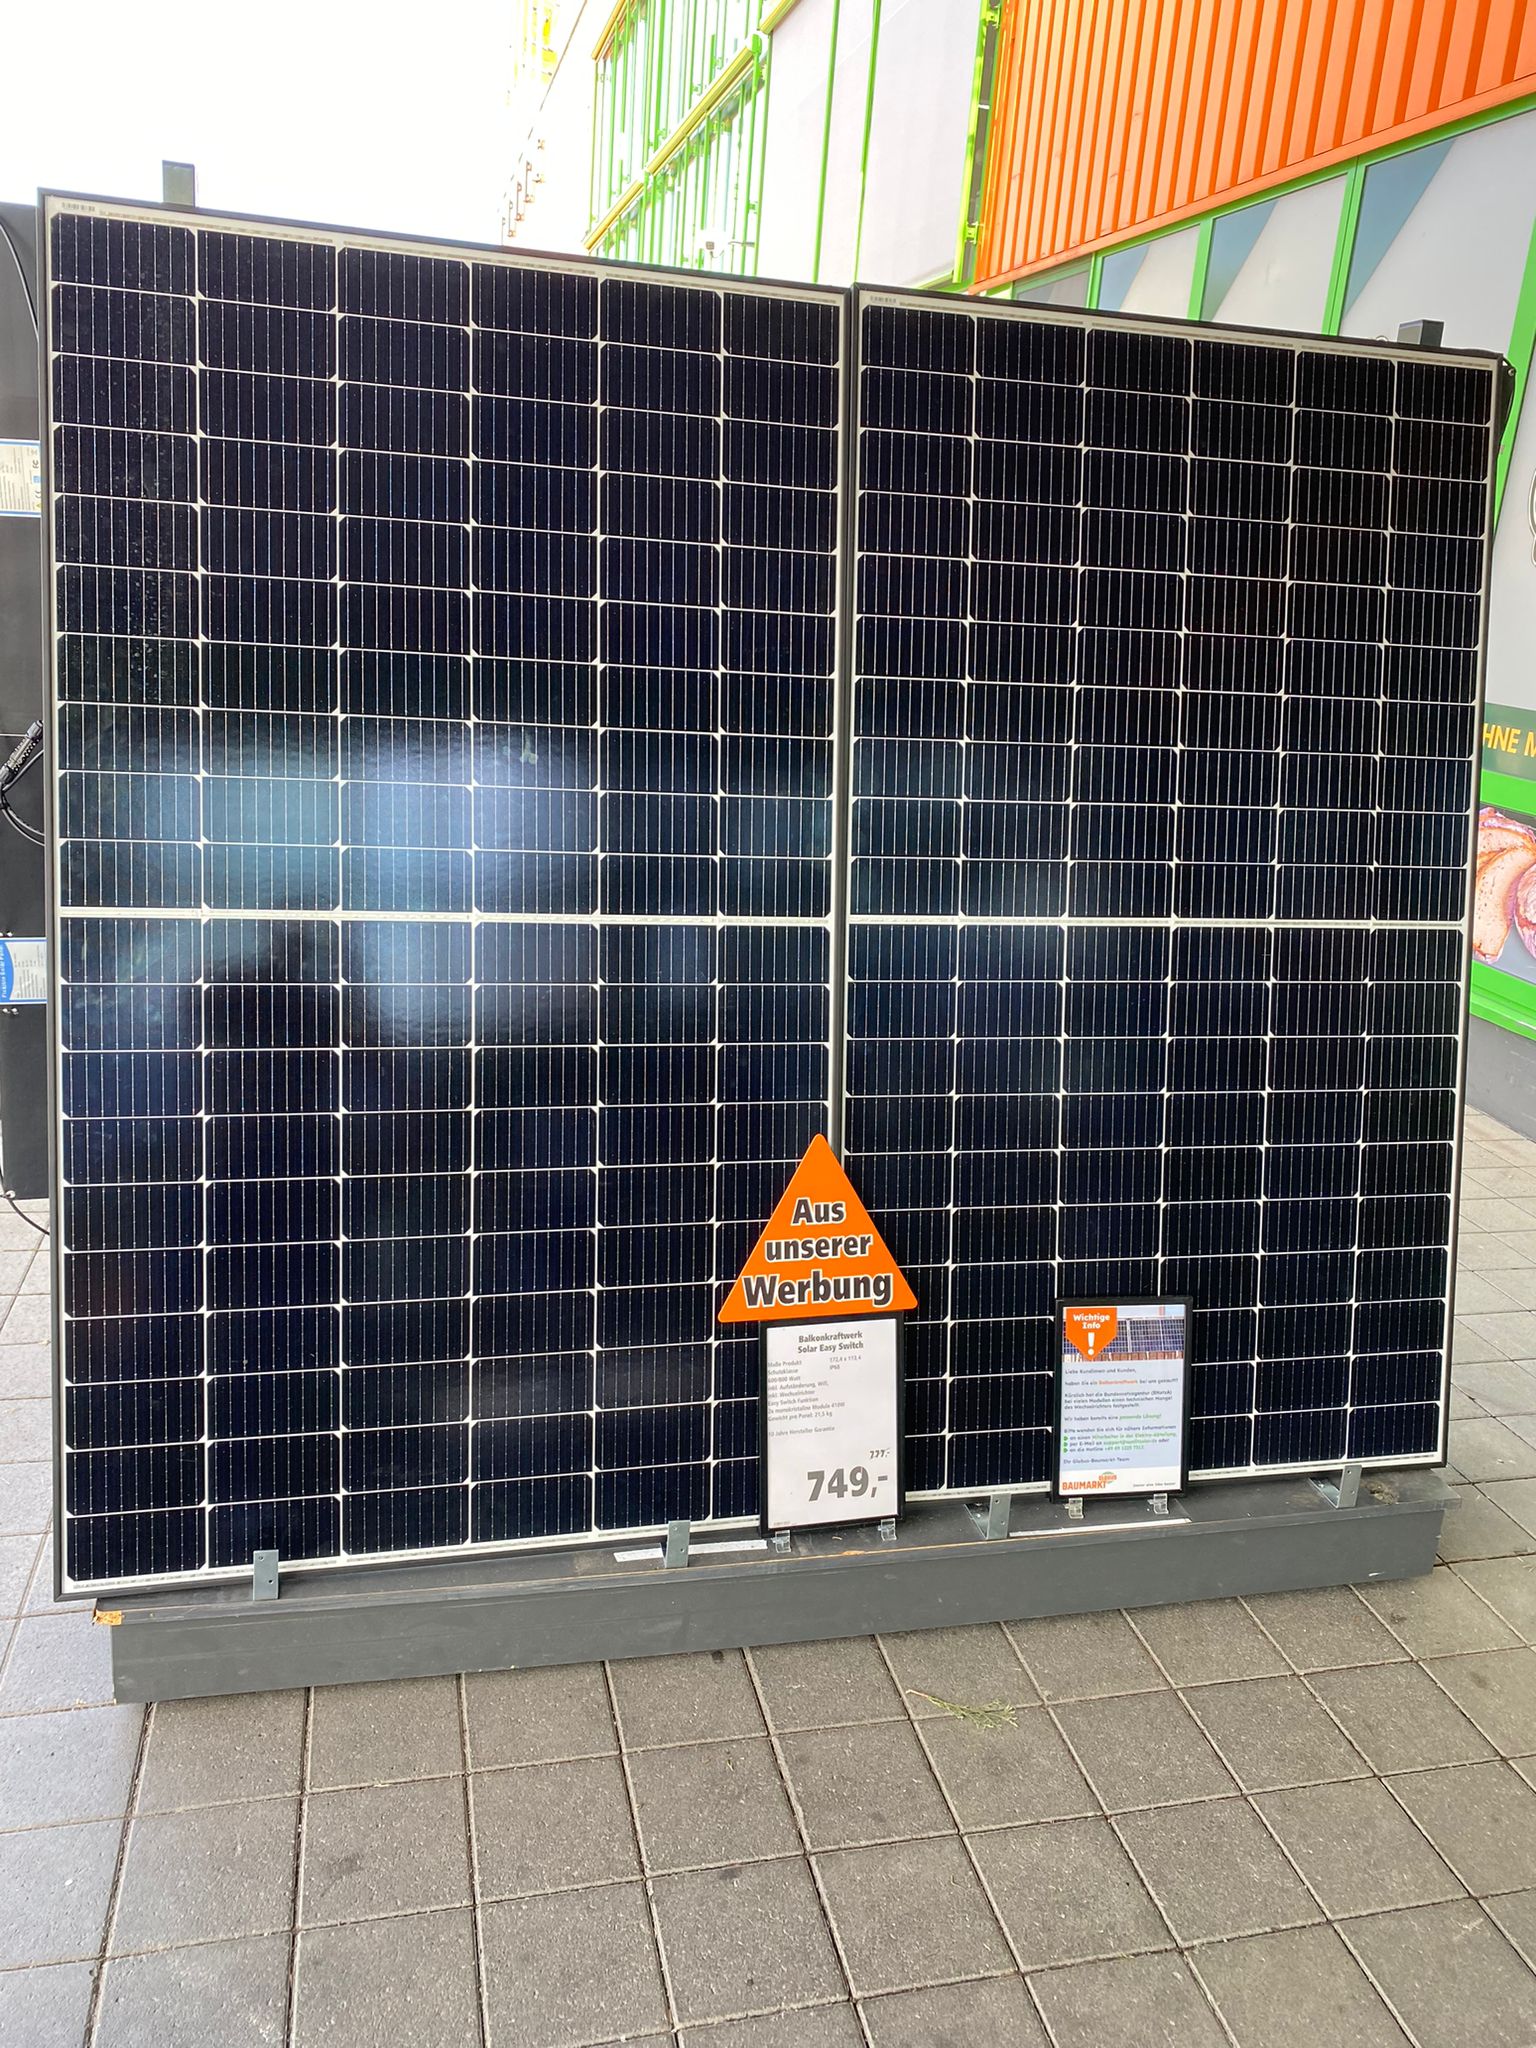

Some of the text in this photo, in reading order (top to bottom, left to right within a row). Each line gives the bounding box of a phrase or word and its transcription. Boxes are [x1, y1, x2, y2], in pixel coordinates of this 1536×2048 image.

[1483, 722, 1520, 753] HNE
[791, 1197, 846, 1226] Aus
[765, 1234, 873, 1262] unserer
[742, 1269, 893, 1308] Werbung
[1073, 1313, 1110, 1321] Wichtige
[798, 1341, 863, 1354] Solar Easy Switch
[799, 1331, 863, 1343] Balkonkraftwerk
[807, 1466, 888, 1502] 749,-
[1062, 1481, 1107, 1490] BAUMARKT
